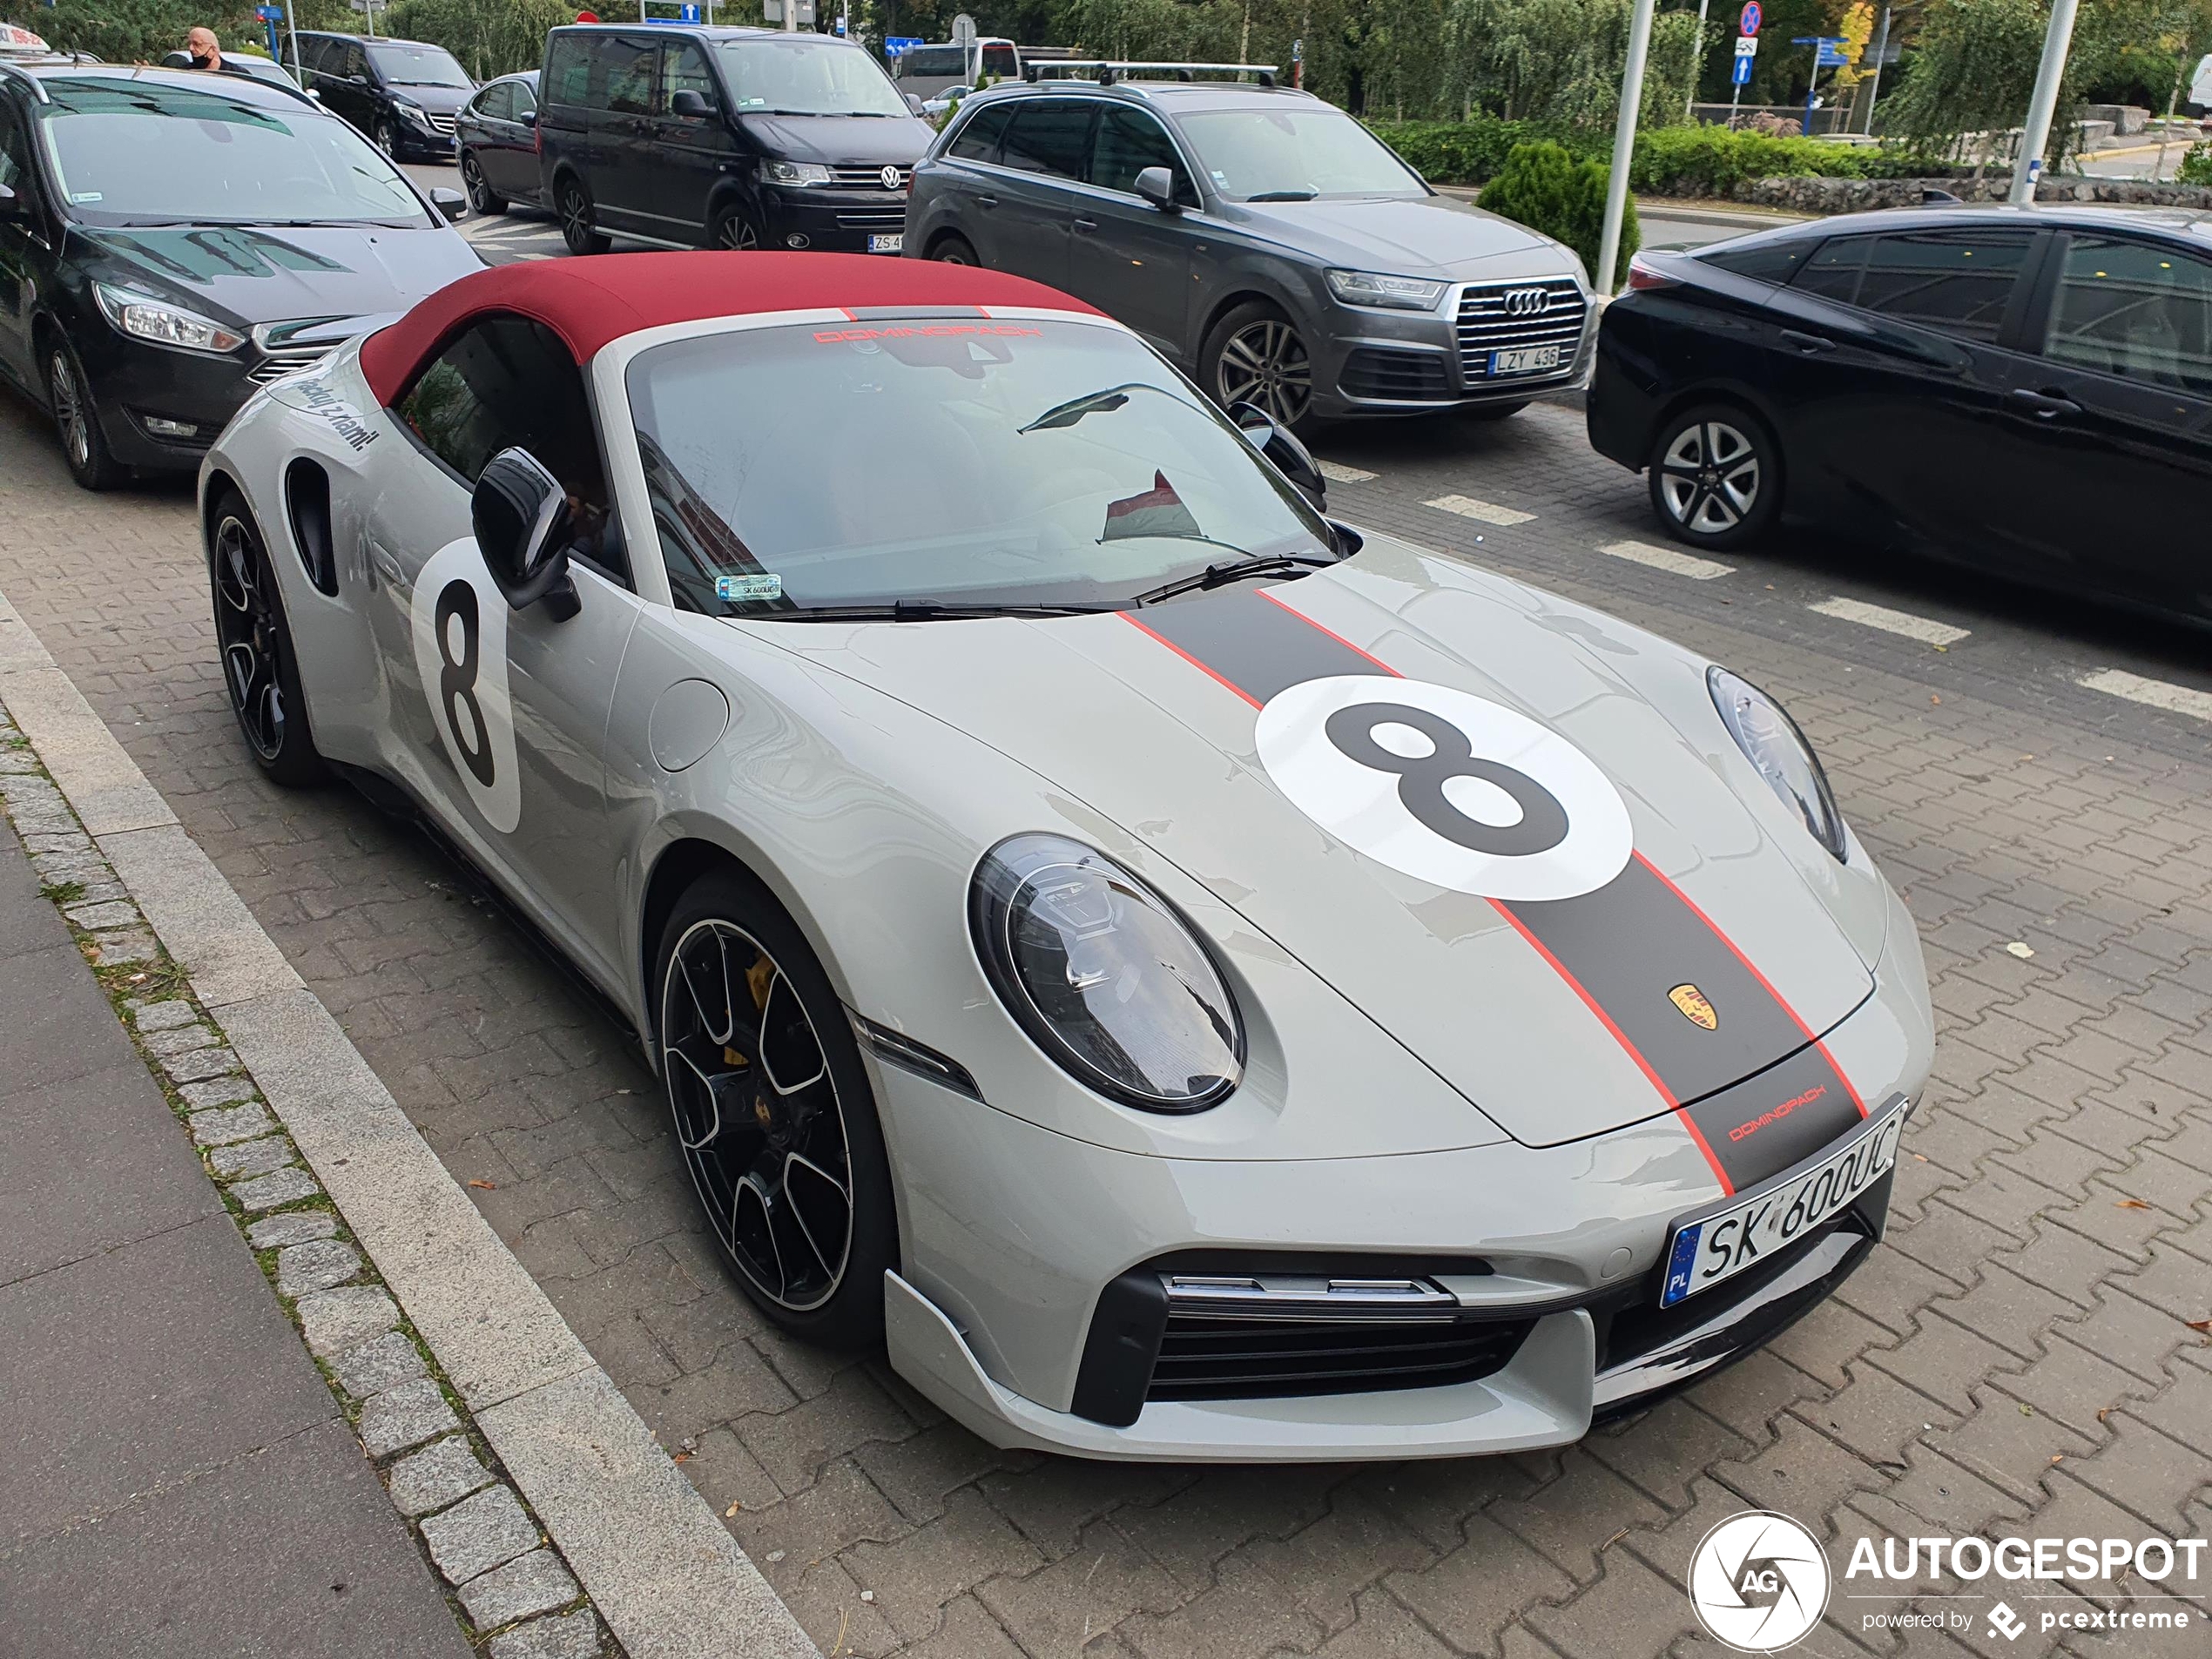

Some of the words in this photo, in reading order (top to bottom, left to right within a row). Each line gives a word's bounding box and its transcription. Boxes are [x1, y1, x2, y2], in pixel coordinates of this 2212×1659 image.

[875, 236, 891, 249] ZS
[813, 326, 1043, 343] DOMINOPACK
[1497, 353, 1527, 371] LZY
[1534, 348, 1557, 366] 436
[328, 414, 380, 452] nami!
[435, 578, 495, 788] 8
[1325, 702, 1569, 857] 8
[1728, 1084, 1827, 1142] DOMINOPACK
[1703, 1200, 1771, 1278] SK
[1781, 1120, 1896, 1238] 600UC
[1669, 1272, 1687, 1292] PL
